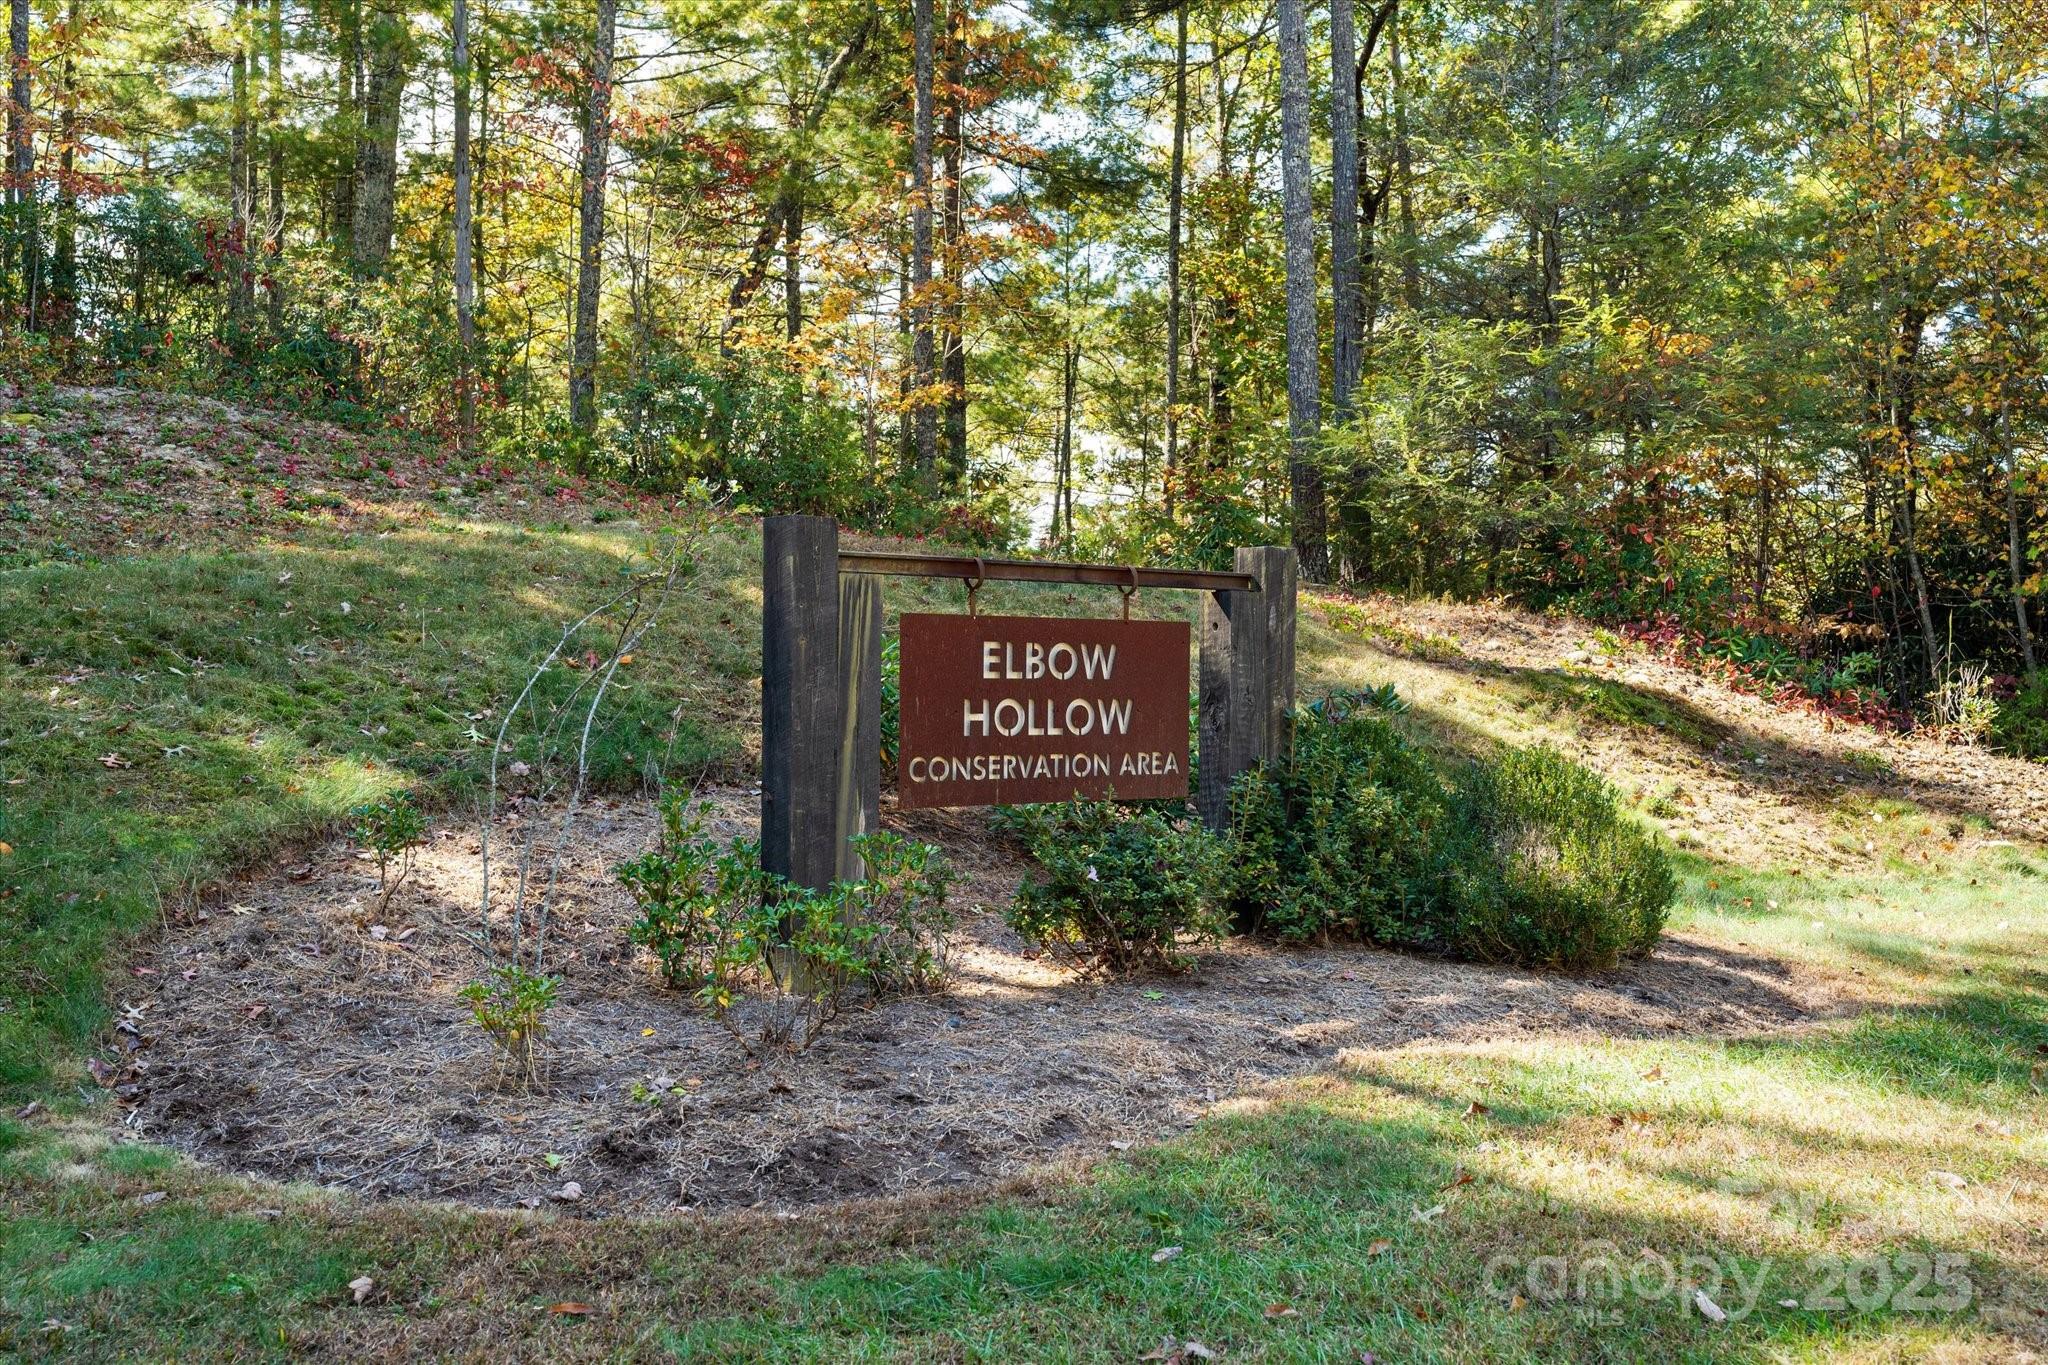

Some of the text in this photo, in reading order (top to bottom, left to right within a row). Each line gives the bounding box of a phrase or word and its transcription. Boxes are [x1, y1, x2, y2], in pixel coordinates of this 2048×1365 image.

[982, 641, 1117, 680] ELBOW
[963, 698, 1133, 737] HOLLOW
[908, 751, 1180, 783] CONSERVATION AREA
